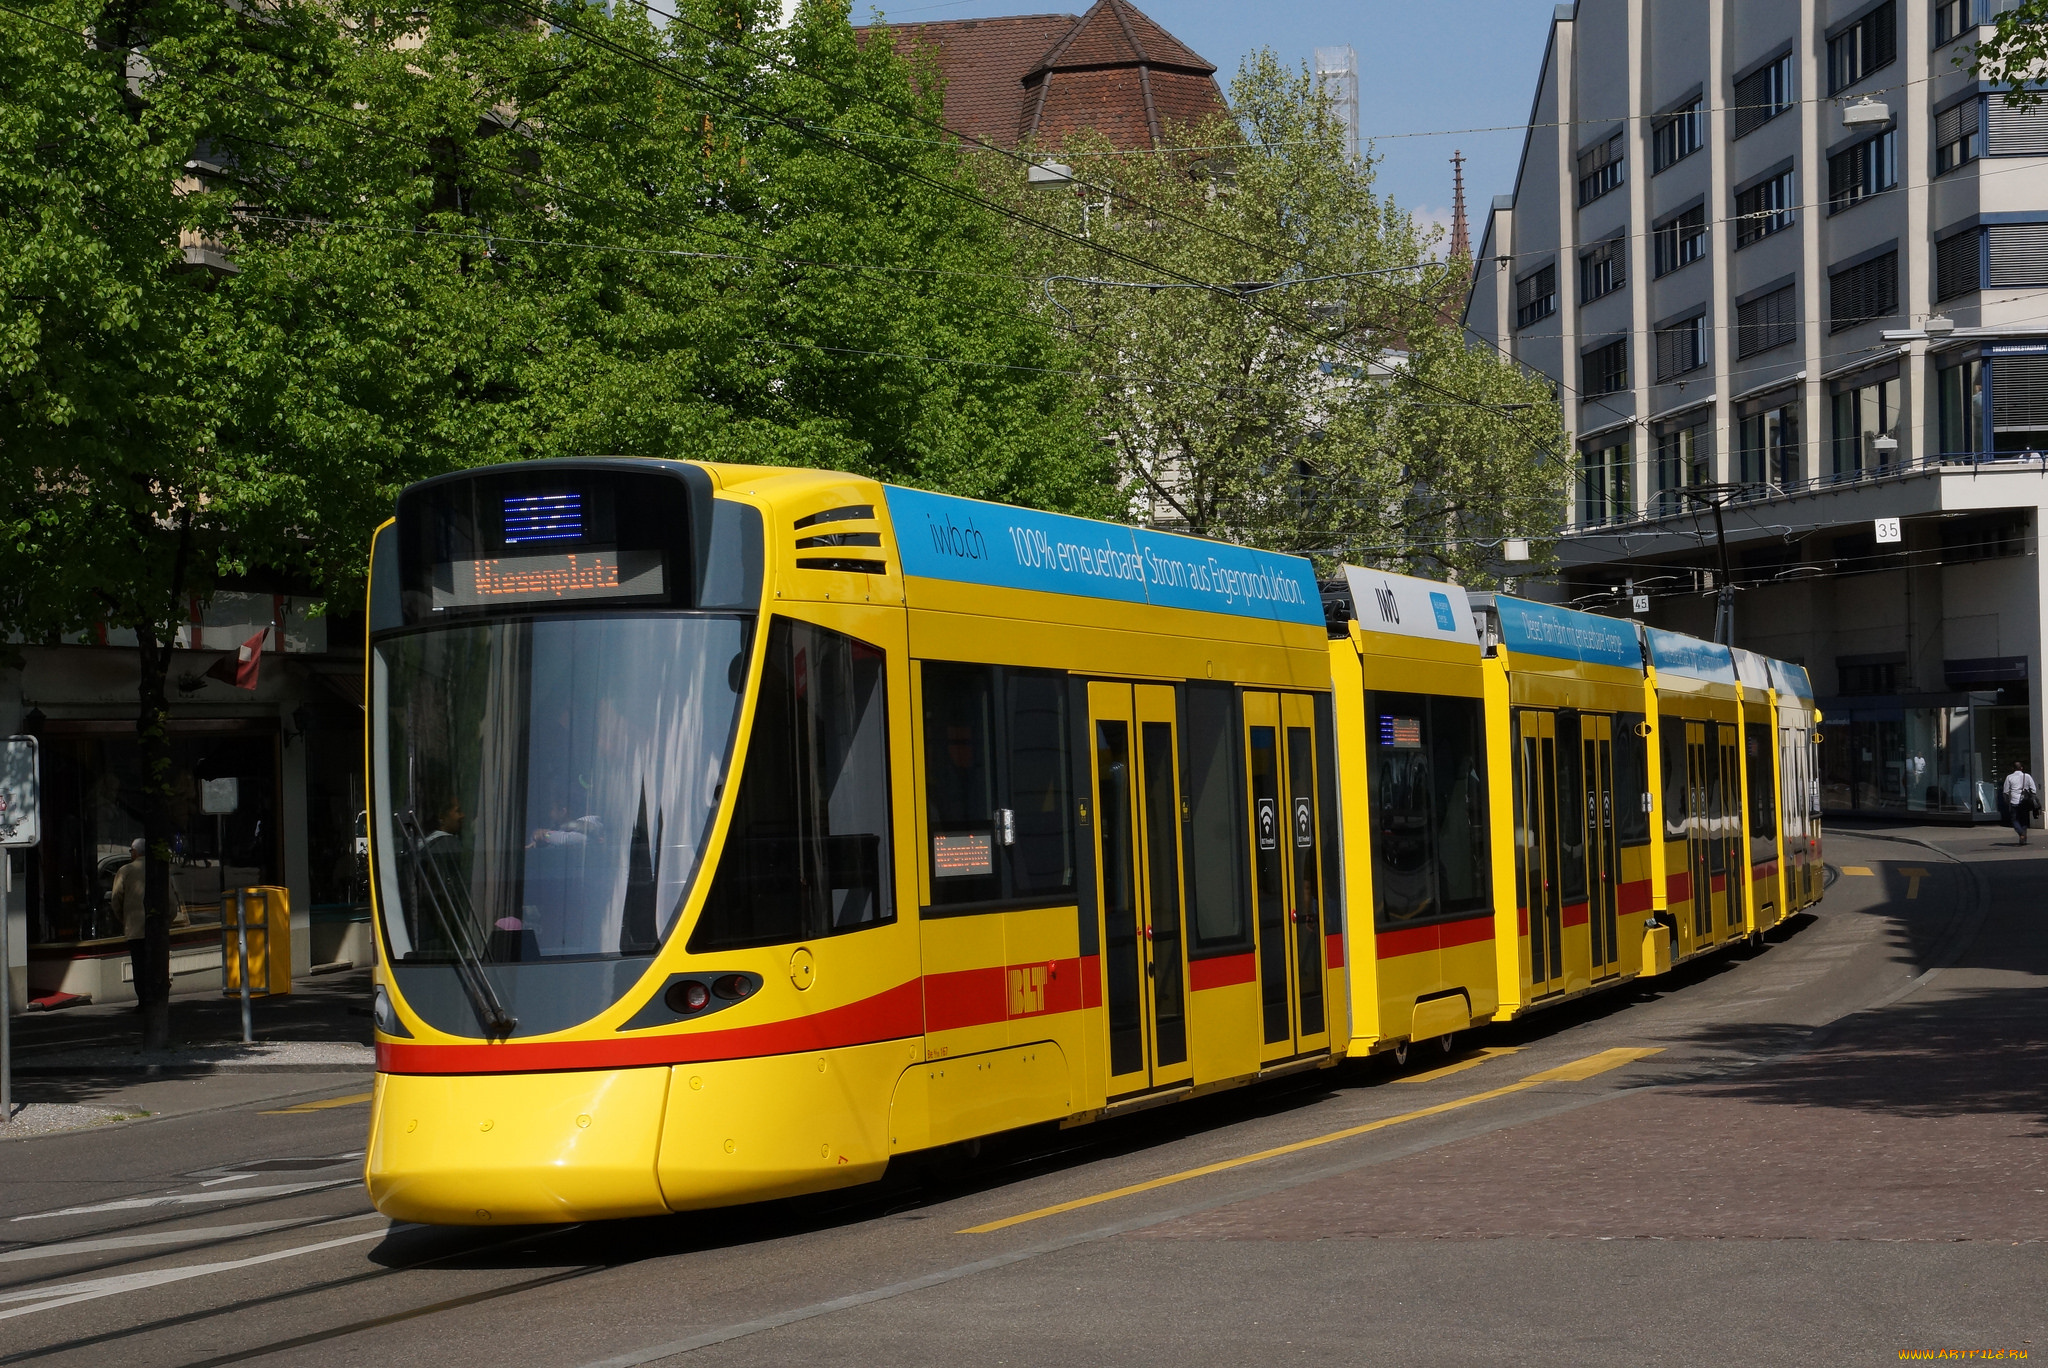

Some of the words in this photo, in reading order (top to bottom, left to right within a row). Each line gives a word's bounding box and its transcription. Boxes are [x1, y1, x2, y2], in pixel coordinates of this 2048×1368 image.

[1992, 344, 2047, 353] THEATERRESTAURANT
[926, 512, 988, 561] iwb.ch
[1878, 522, 1898, 538] 35
[1009, 526, 1057, 570] 100%
[1057, 538, 1143, 583] erneuerbarer
[1144, 546, 1188, 589] Strom
[1187, 562, 1211, 592] aus
[1208, 556, 1306, 607] Eigenproduktion.
[1635, 598, 1647, 609] 45
[1008, 965, 1047, 1015] BLT
